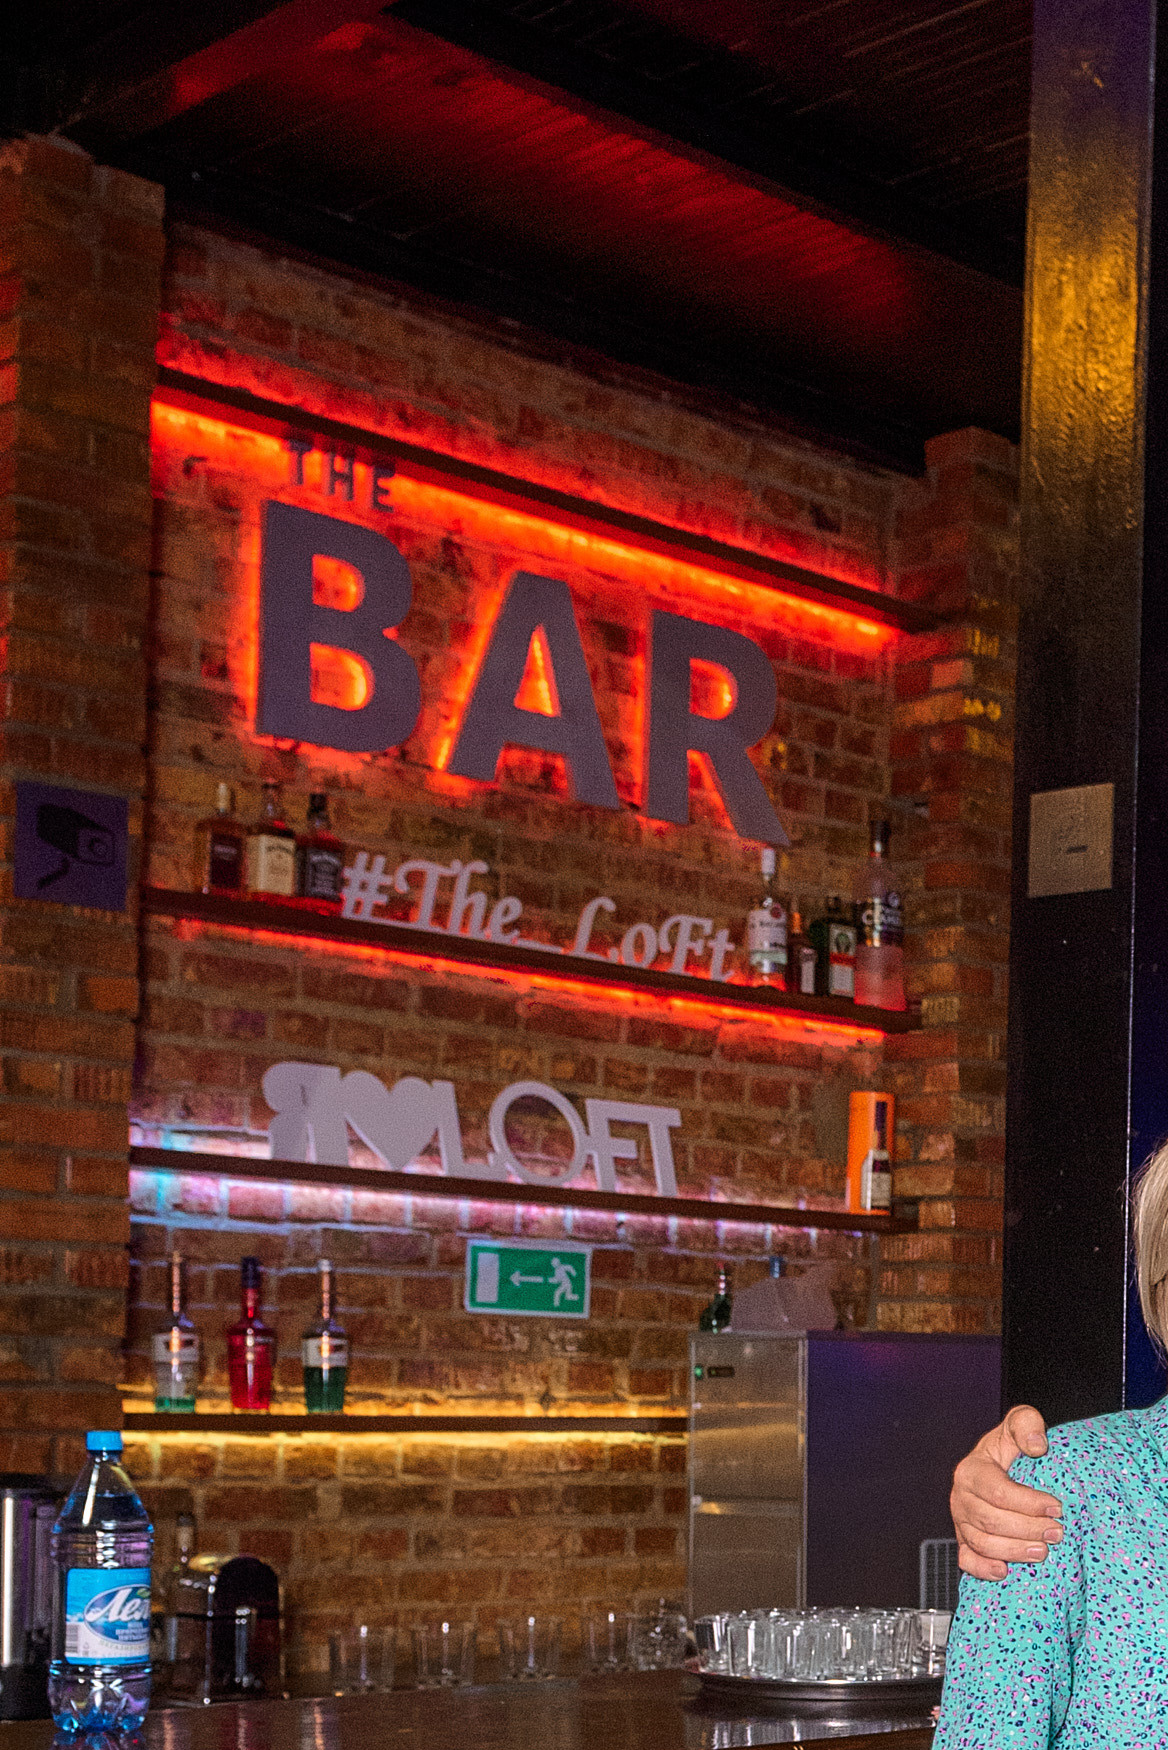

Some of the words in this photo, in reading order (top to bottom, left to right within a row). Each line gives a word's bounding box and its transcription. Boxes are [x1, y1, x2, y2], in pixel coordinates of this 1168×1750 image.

[288, 439, 396, 513] THE
[255, 498, 793, 848] BAR
[432, 1080, 682, 1197] LOFT
